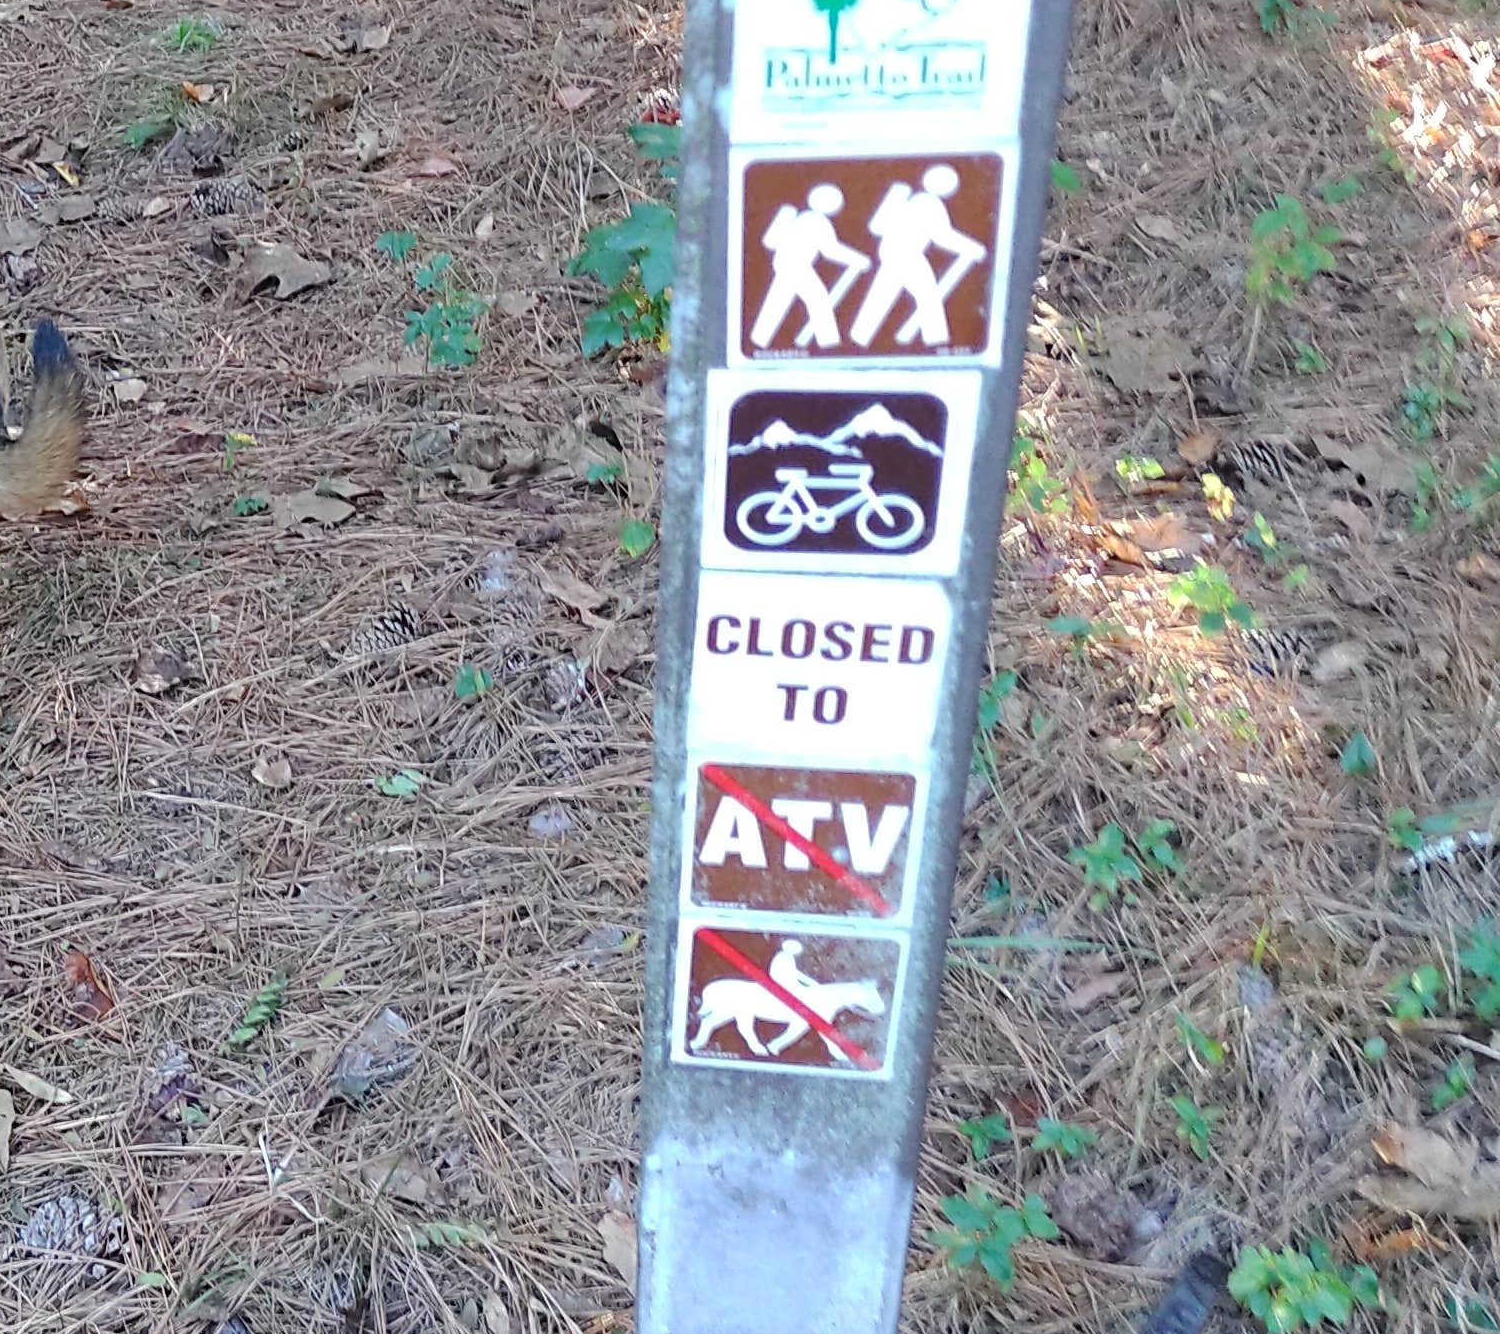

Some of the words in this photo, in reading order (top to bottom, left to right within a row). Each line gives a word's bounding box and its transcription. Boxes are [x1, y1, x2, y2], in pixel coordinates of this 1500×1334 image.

[706, 614, 935, 665] CLOSED
[777, 683, 848, 725] TO
[699, 795, 909, 875] ATV
